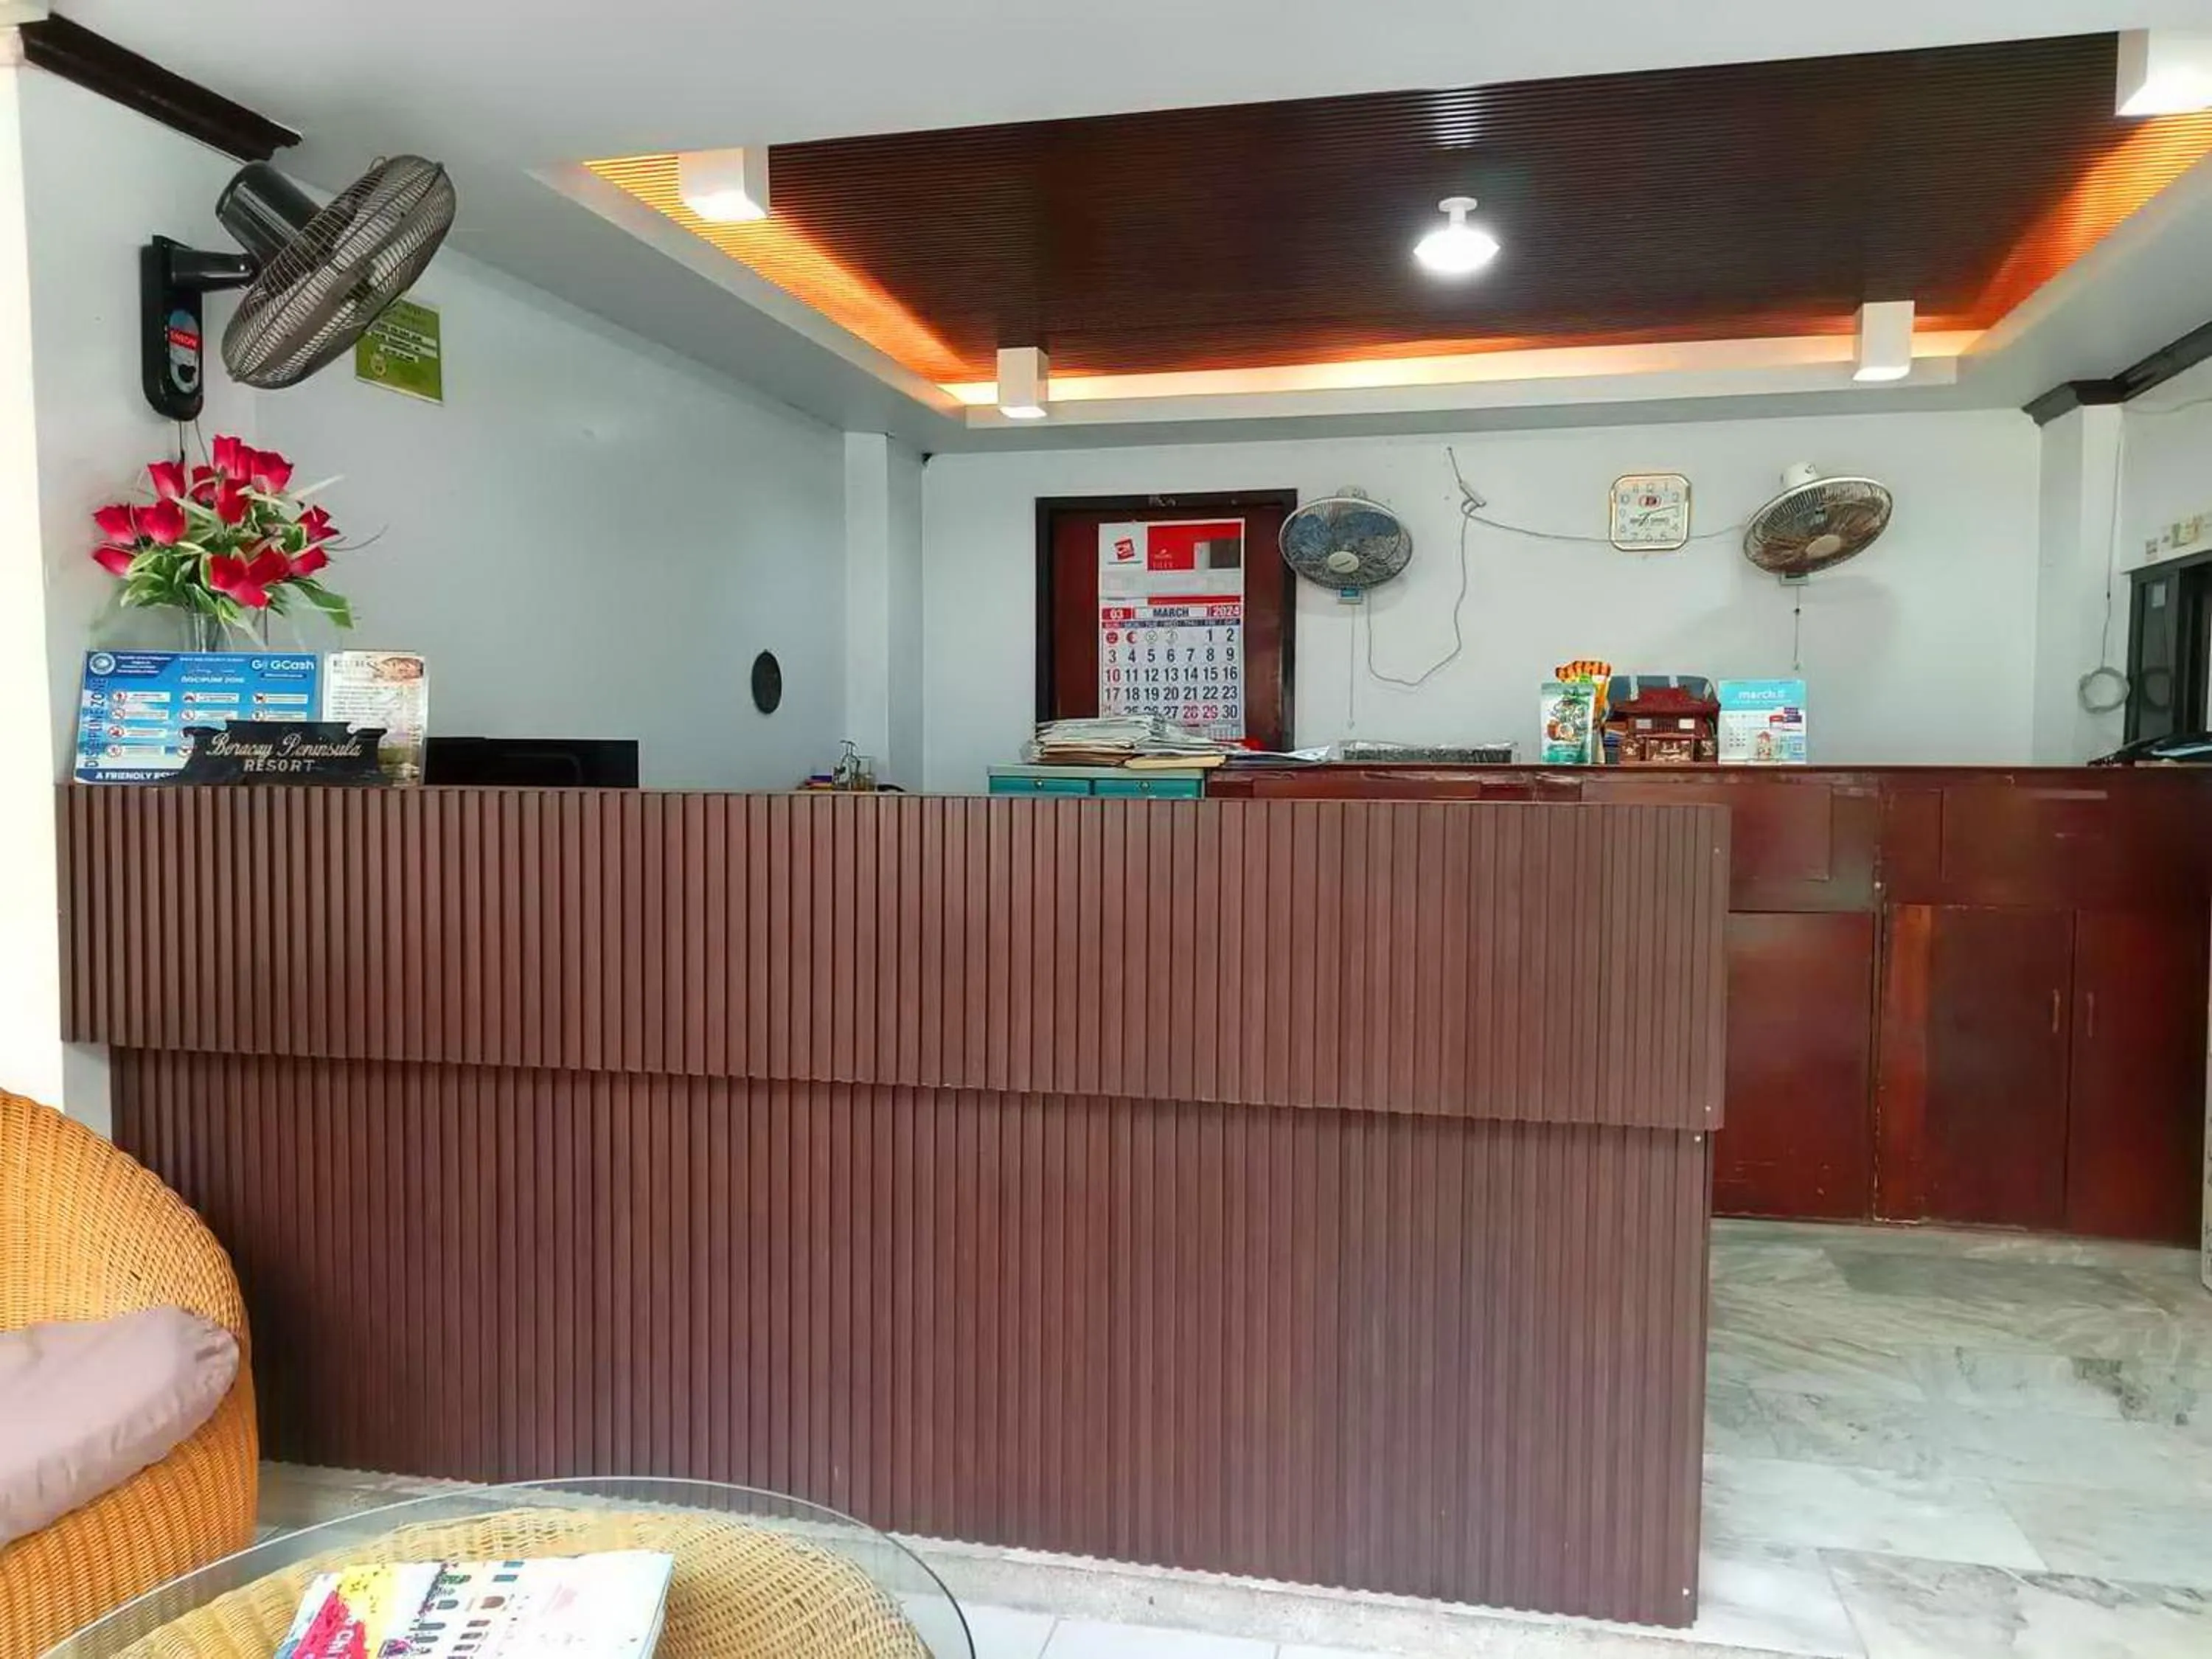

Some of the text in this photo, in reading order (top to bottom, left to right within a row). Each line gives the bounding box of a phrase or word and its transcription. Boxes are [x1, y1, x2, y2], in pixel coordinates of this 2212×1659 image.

[1152, 608, 1189, 617] MARCH
[1212, 605, 1241, 616] 2024
[1207, 628, 1234, 642] 1 2
[1108, 647, 1235, 663] 3 4 5 6 7 8 9
[271, 659, 315, 670] GCash
[1106, 666, 1238, 683] 10 11 12 13 14 15 16
[1106, 685, 1238, 701] 17 18 19 20 21 22 23
[1164, 706, 1179, 719] 27
[1183, 705, 1198, 719] 28
[1203, 705, 1218, 719] 29
[1222, 704, 1238, 719] 30
[276, 731, 363, 757] Peninsula
[243, 759, 316, 772] RESORT
[95, 771, 103, 779] A
[105, 771, 152, 780] FRIENDLY
